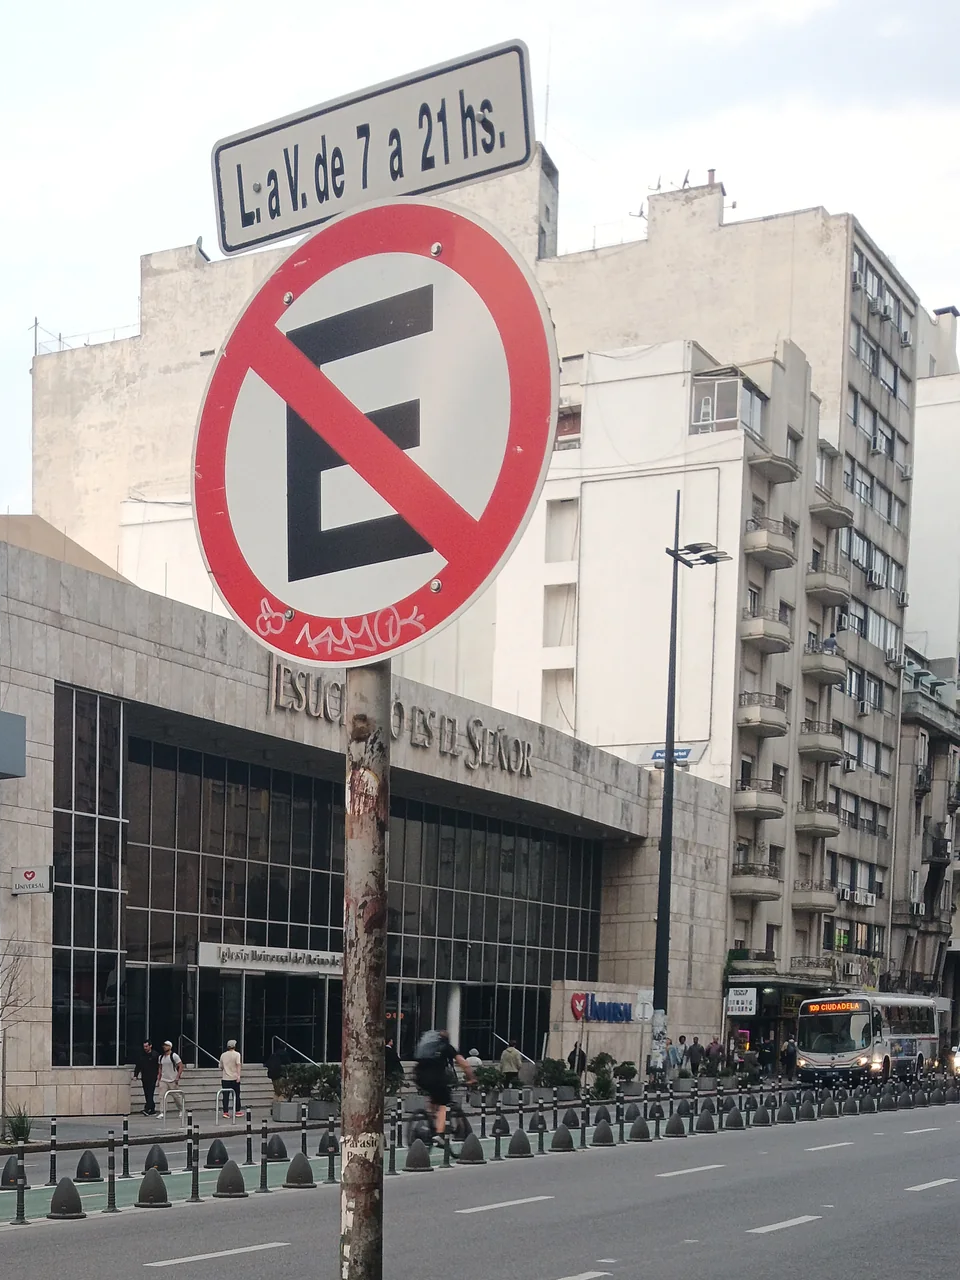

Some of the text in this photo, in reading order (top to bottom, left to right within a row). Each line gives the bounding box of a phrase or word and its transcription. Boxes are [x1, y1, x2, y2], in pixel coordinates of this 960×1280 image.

[266, 168, 281, 219] a
[314, 134, 345, 204] de
[356, 122, 370, 189] 7
[388, 127, 404, 182] a
[418, 97, 450, 172] 21
[458, 88, 506, 160] hs.
[286, 283, 434, 583] E
[821, 1002, 860, 1011] CIUDADELA
